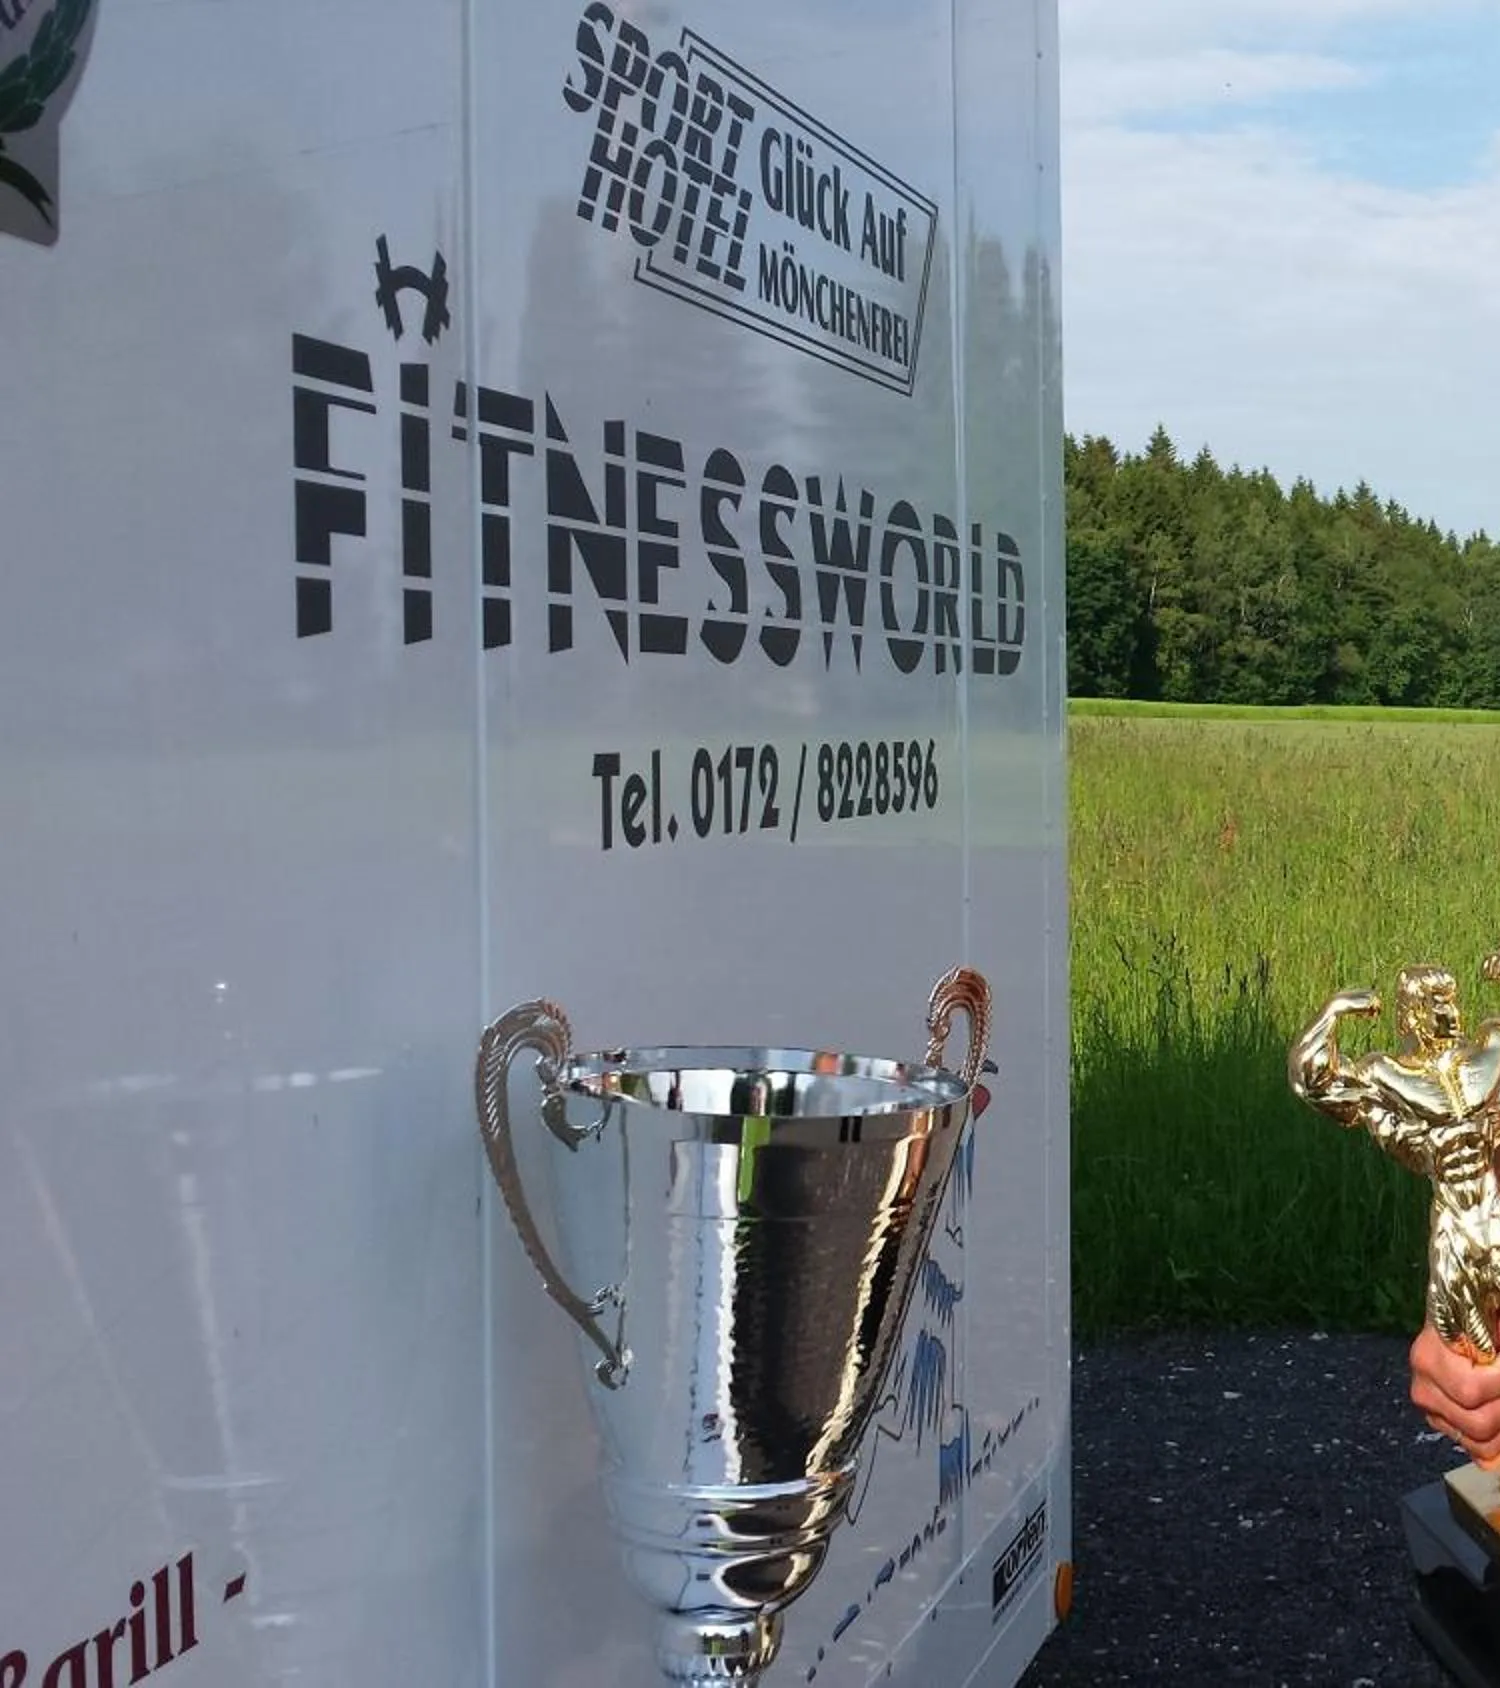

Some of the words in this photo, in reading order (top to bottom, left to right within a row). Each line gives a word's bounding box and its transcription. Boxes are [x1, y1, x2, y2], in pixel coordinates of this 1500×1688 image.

[563, 0, 755, 180] SPORT
[576, 100, 753, 291] HOTEL
[760, 127, 852, 252] Glück
[861, 192, 908, 282] Auf
[759, 241, 910, 368] MÖNCHENFREI
[592, 752, 678, 850] Tel.
[691, 743, 779, 839] 0172
[817, 738, 939, 823] 8228596
